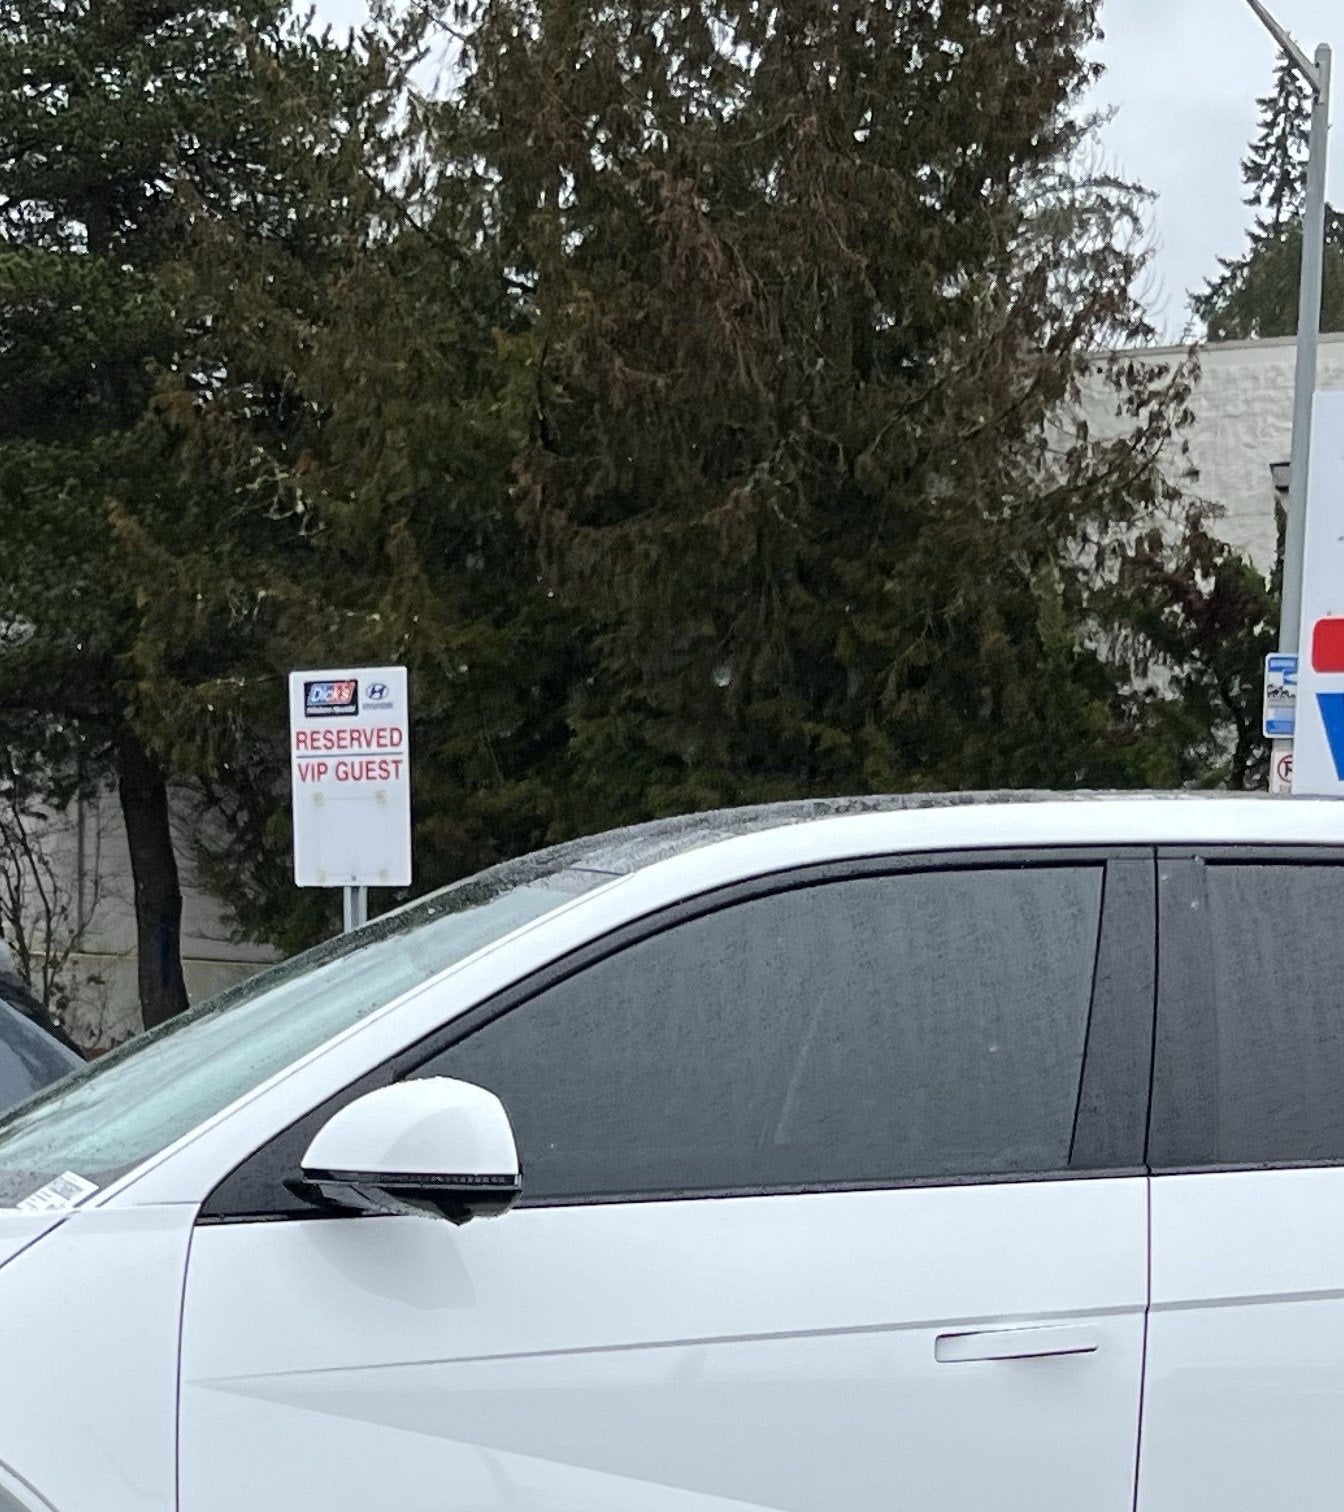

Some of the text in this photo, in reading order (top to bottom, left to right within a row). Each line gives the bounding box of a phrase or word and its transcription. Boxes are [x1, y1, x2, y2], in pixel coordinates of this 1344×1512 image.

[295, 727, 403, 750] RESERVED
[297, 760, 403, 782] VIP GUEST
